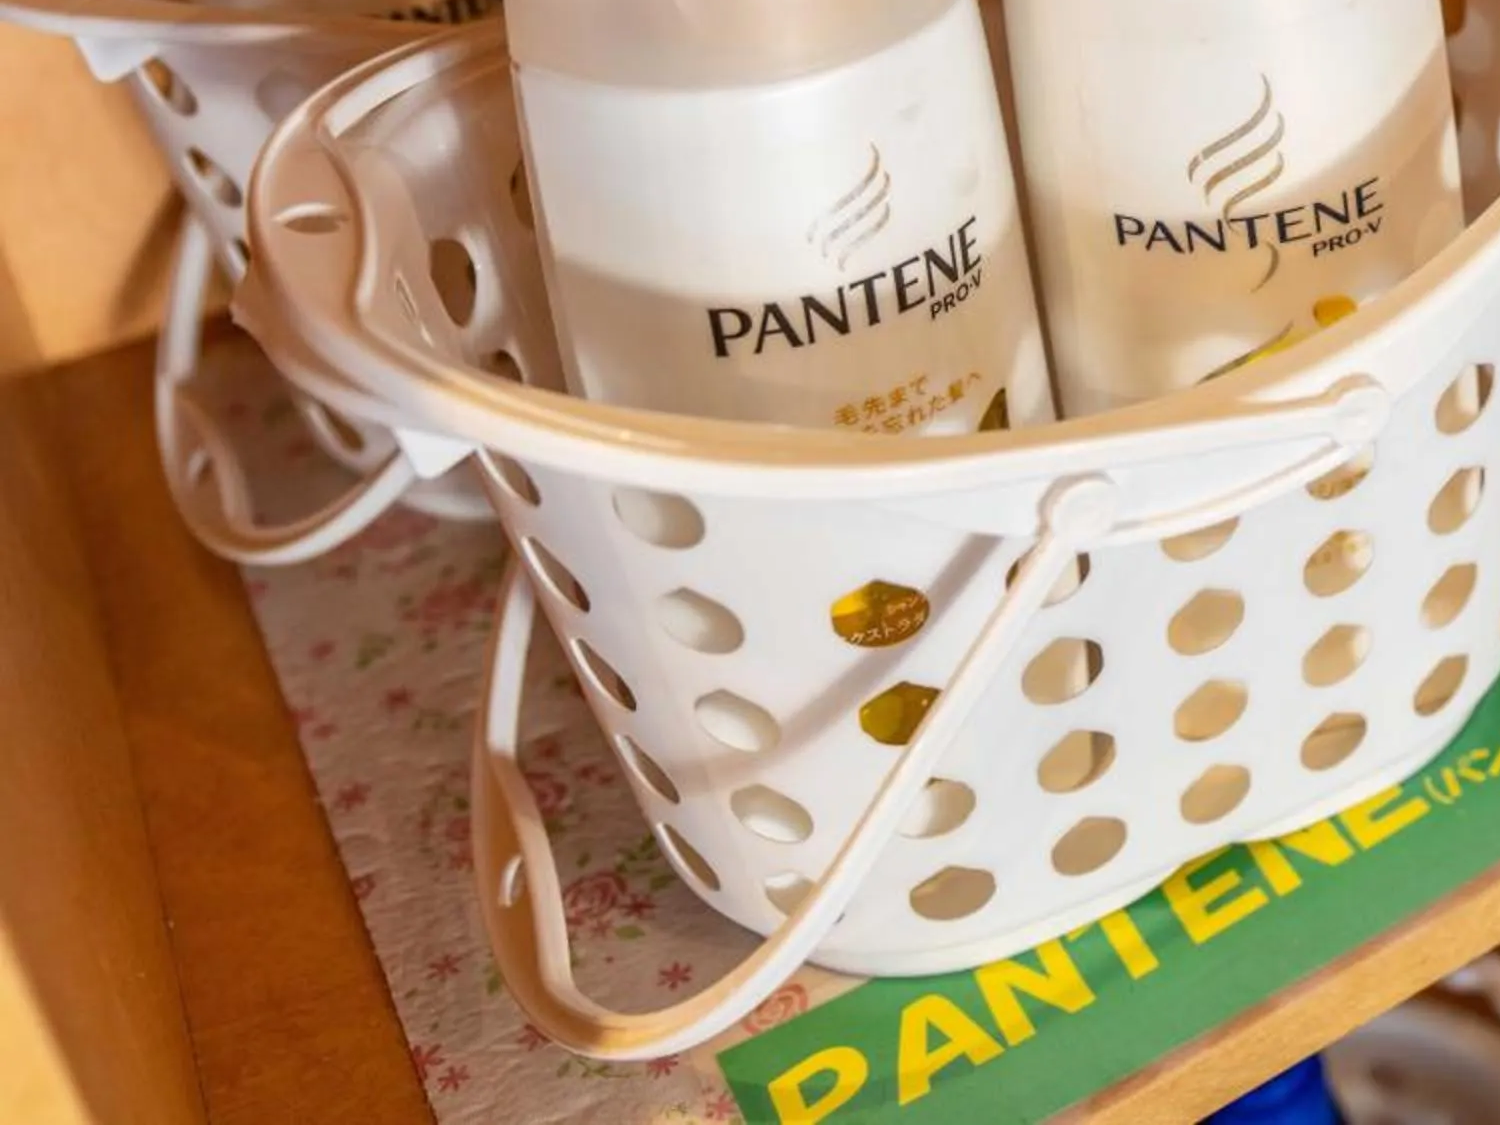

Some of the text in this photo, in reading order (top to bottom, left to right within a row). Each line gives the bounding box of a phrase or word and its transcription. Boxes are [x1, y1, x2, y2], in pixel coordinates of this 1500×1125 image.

[707, 215, 982, 358] PANTENE
[1114, 176, 1384, 254] PANTENE
[768, 783, 1432, 1125] PANTENE
